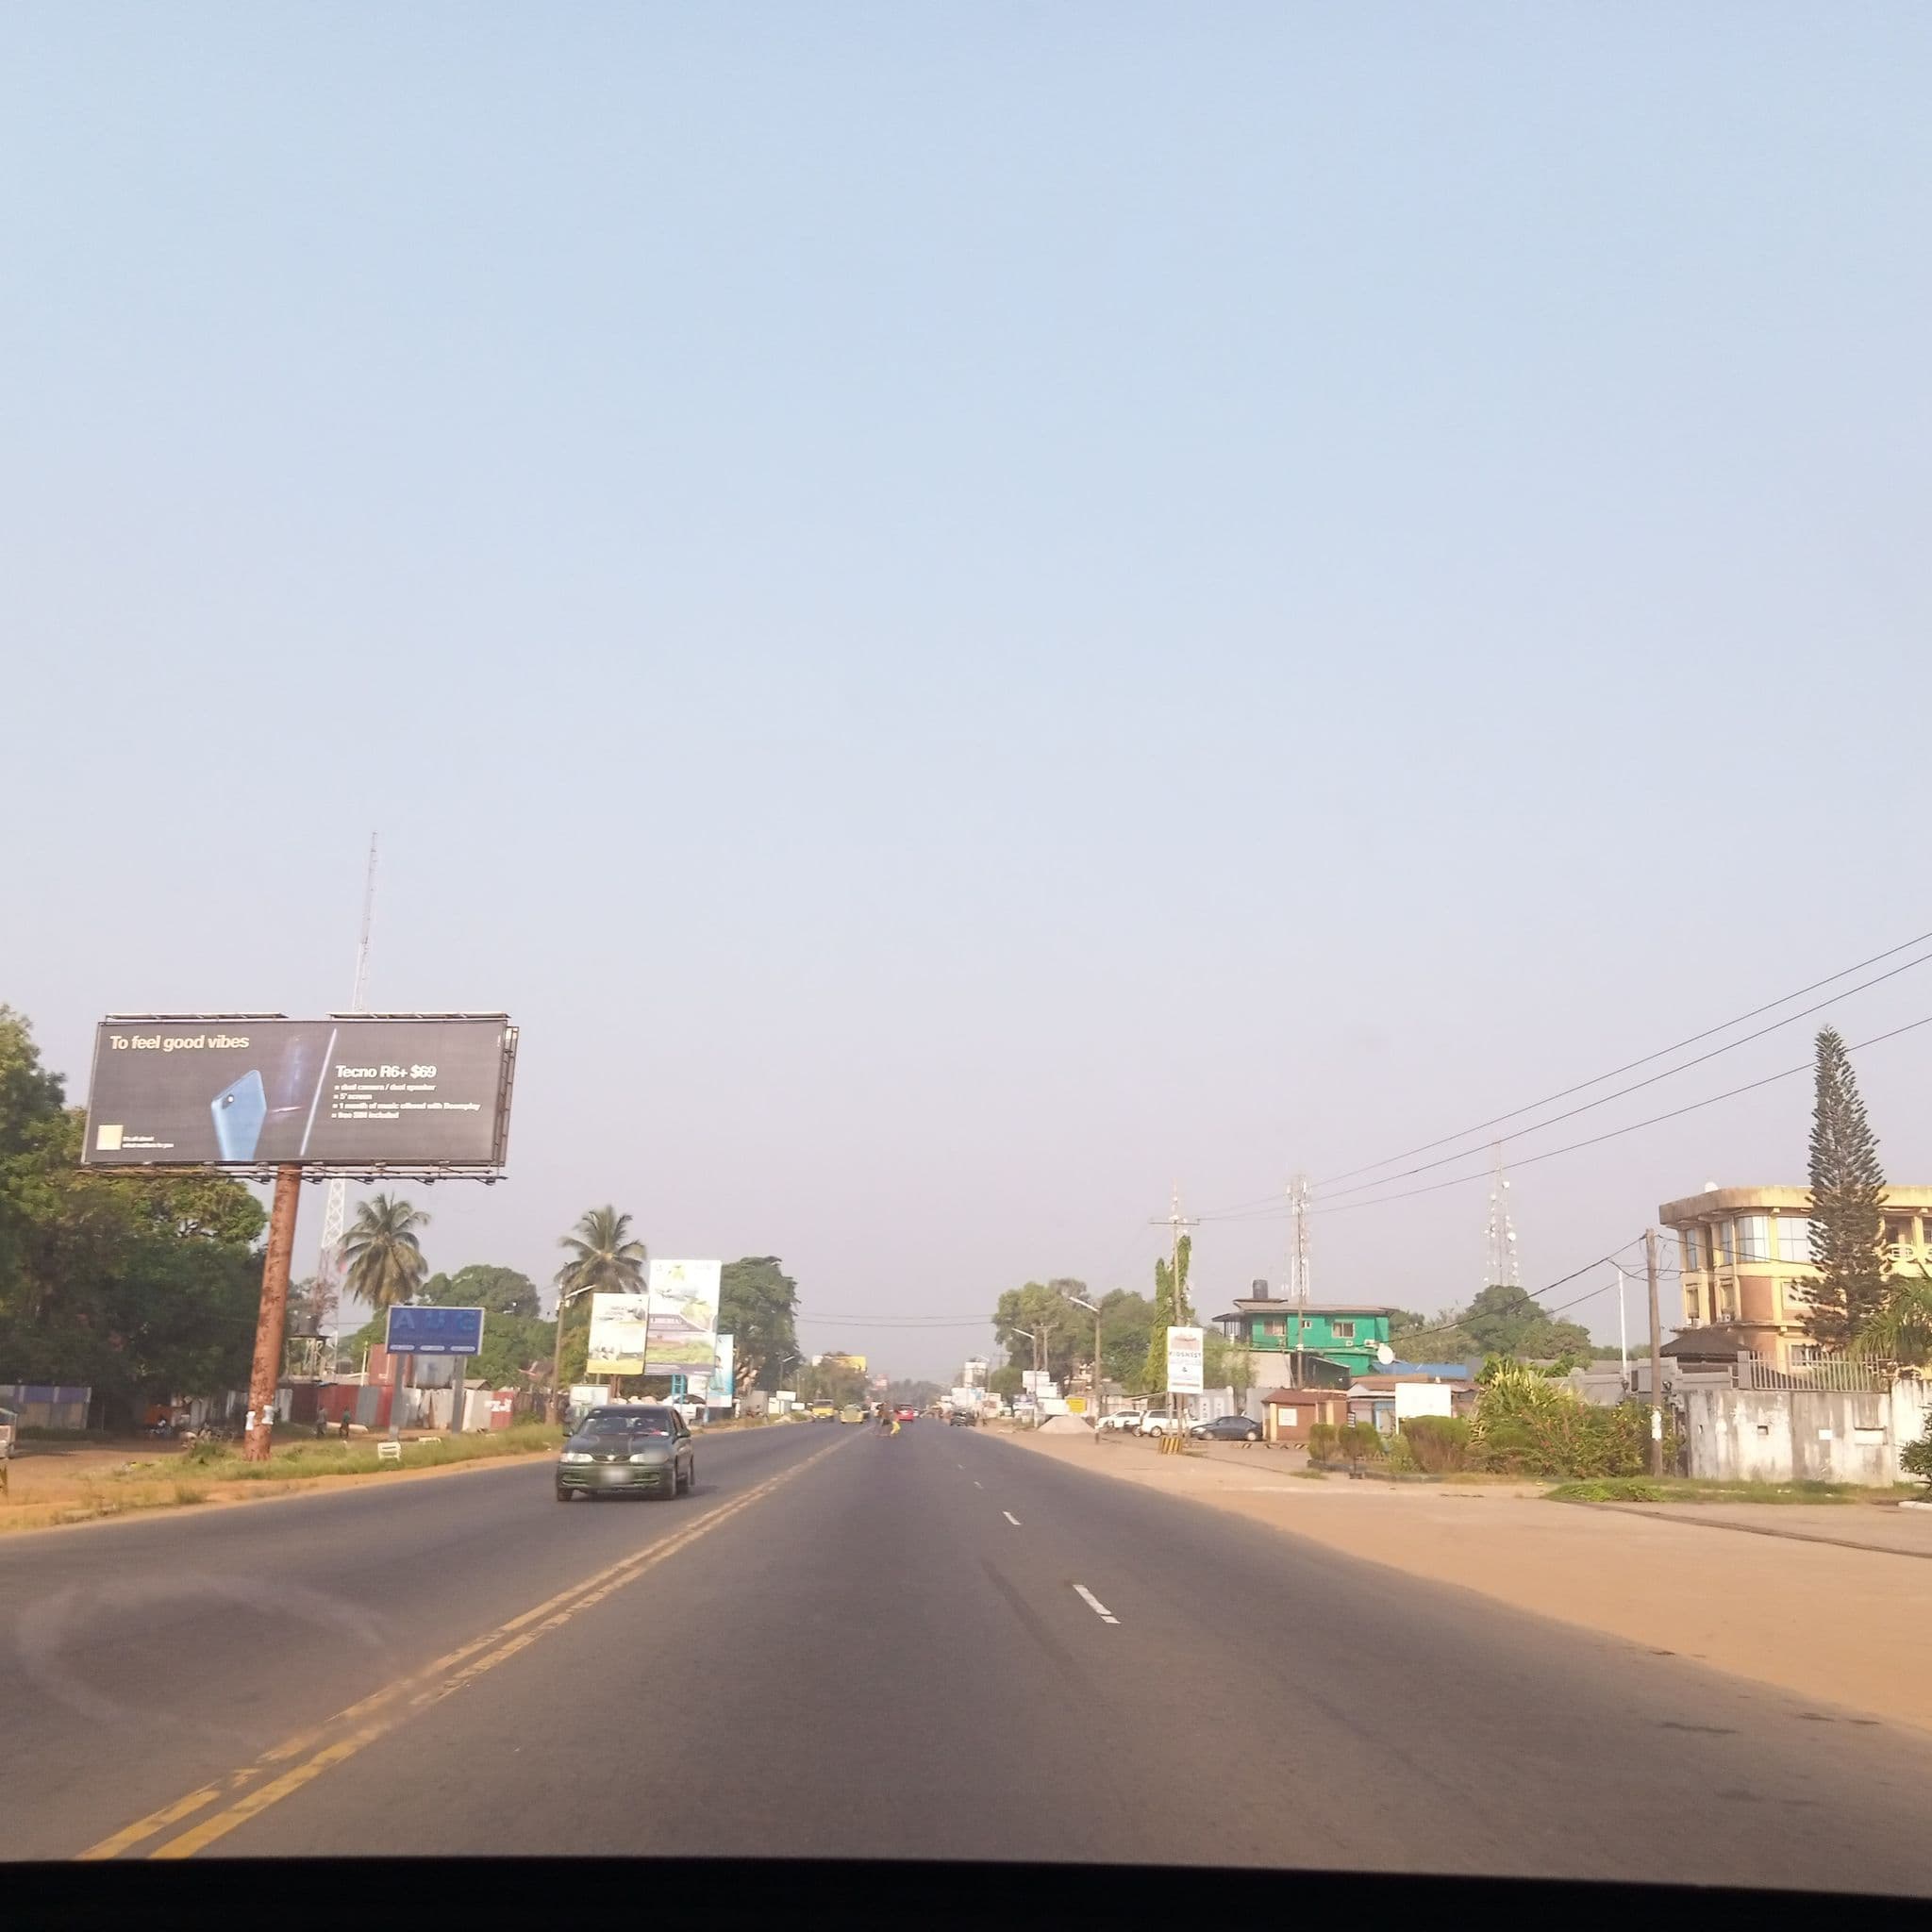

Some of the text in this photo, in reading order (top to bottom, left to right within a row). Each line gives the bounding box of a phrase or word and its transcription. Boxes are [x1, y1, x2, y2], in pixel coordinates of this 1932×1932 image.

[109, 1035, 250, 1052] To feel good vibes
[336, 1064, 437, 1078] Tecno R6+ $69
